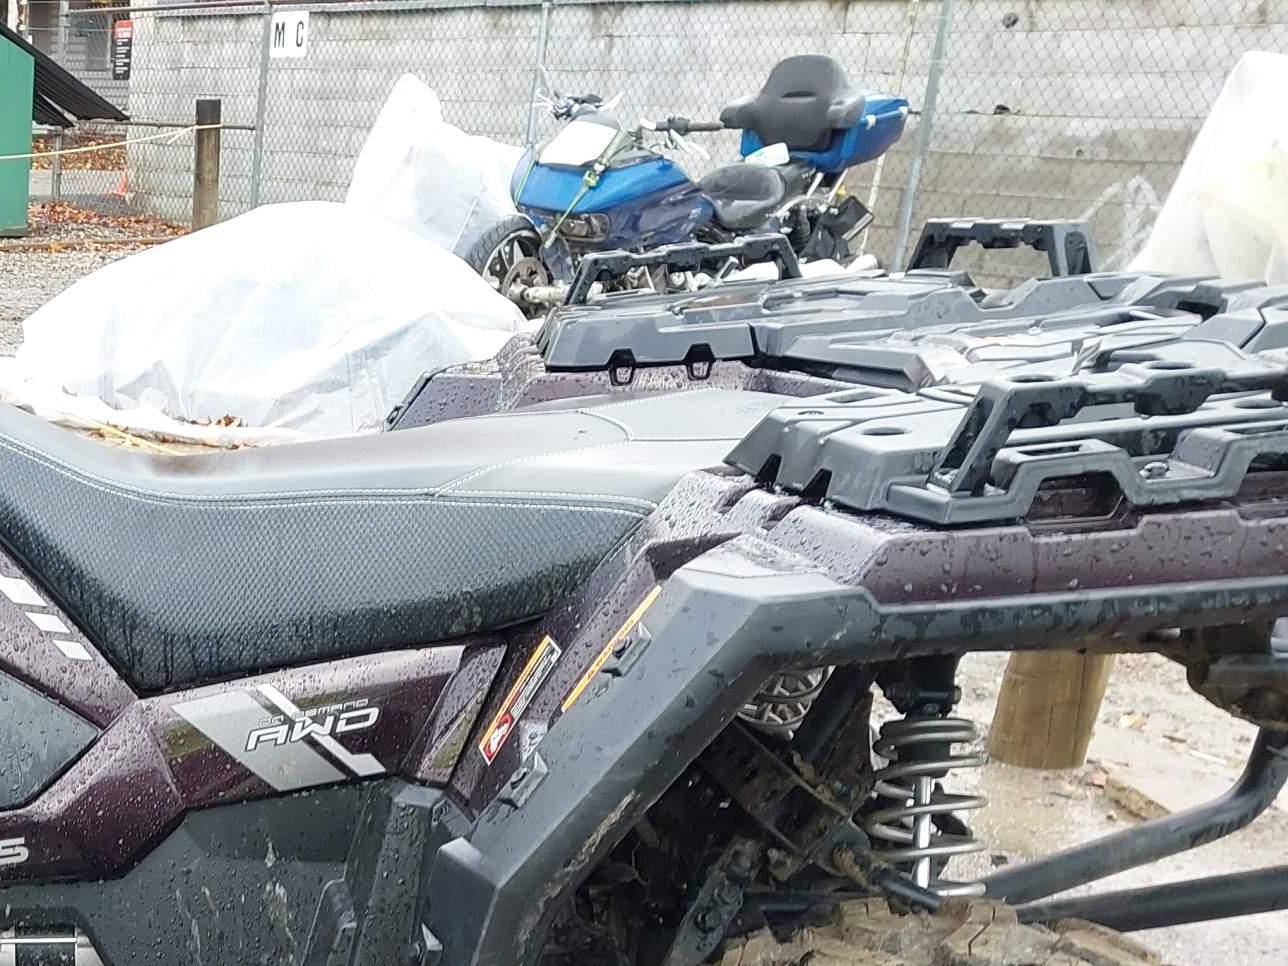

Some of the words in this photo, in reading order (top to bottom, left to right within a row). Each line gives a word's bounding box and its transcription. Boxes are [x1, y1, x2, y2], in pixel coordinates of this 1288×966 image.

[273, 21, 286, 48] M
[295, 20, 305, 48] C
[245, 706, 380, 752] AWD
